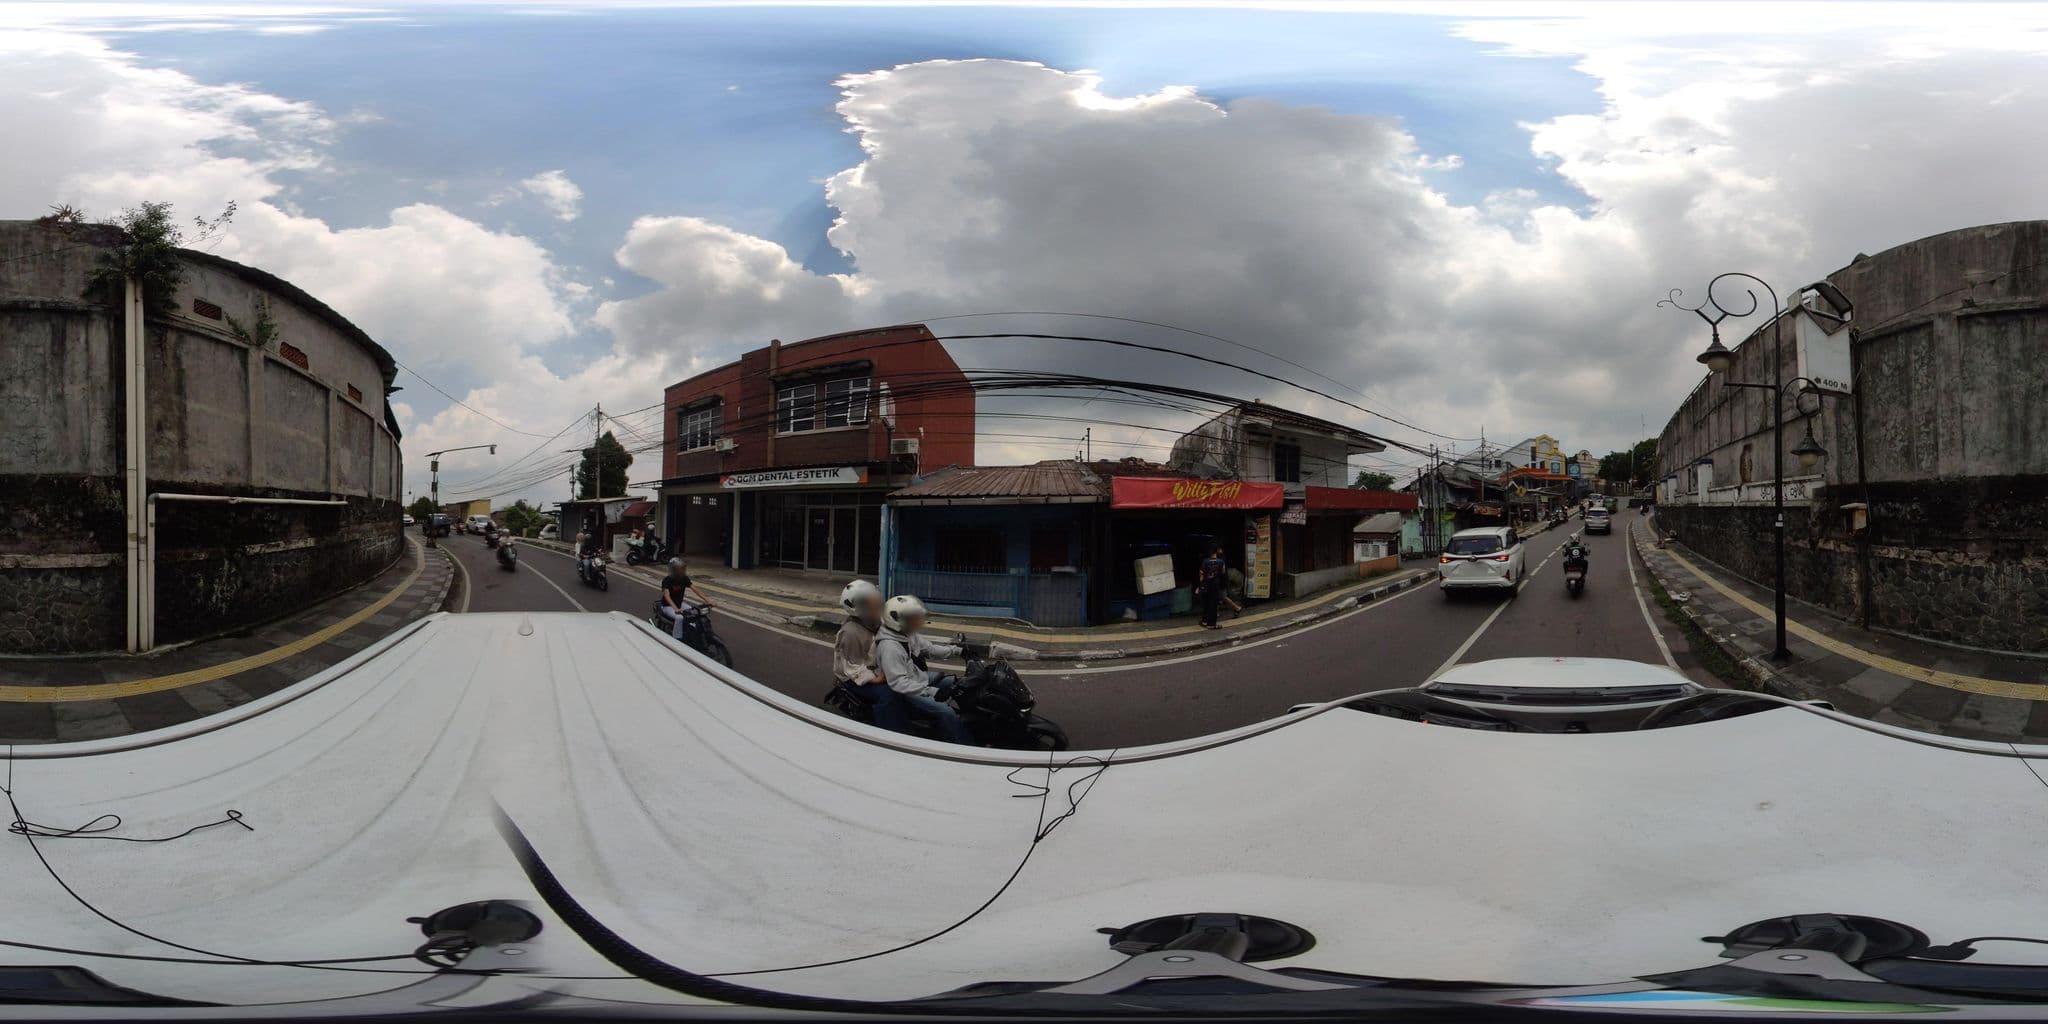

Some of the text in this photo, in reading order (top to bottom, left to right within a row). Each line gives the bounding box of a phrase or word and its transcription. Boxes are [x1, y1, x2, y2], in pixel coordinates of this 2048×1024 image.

[1823, 378, 1848, 390] 400 M
[758, 471, 794, 482] DENTAL
[796, 468, 840, 479] ESTETIK
